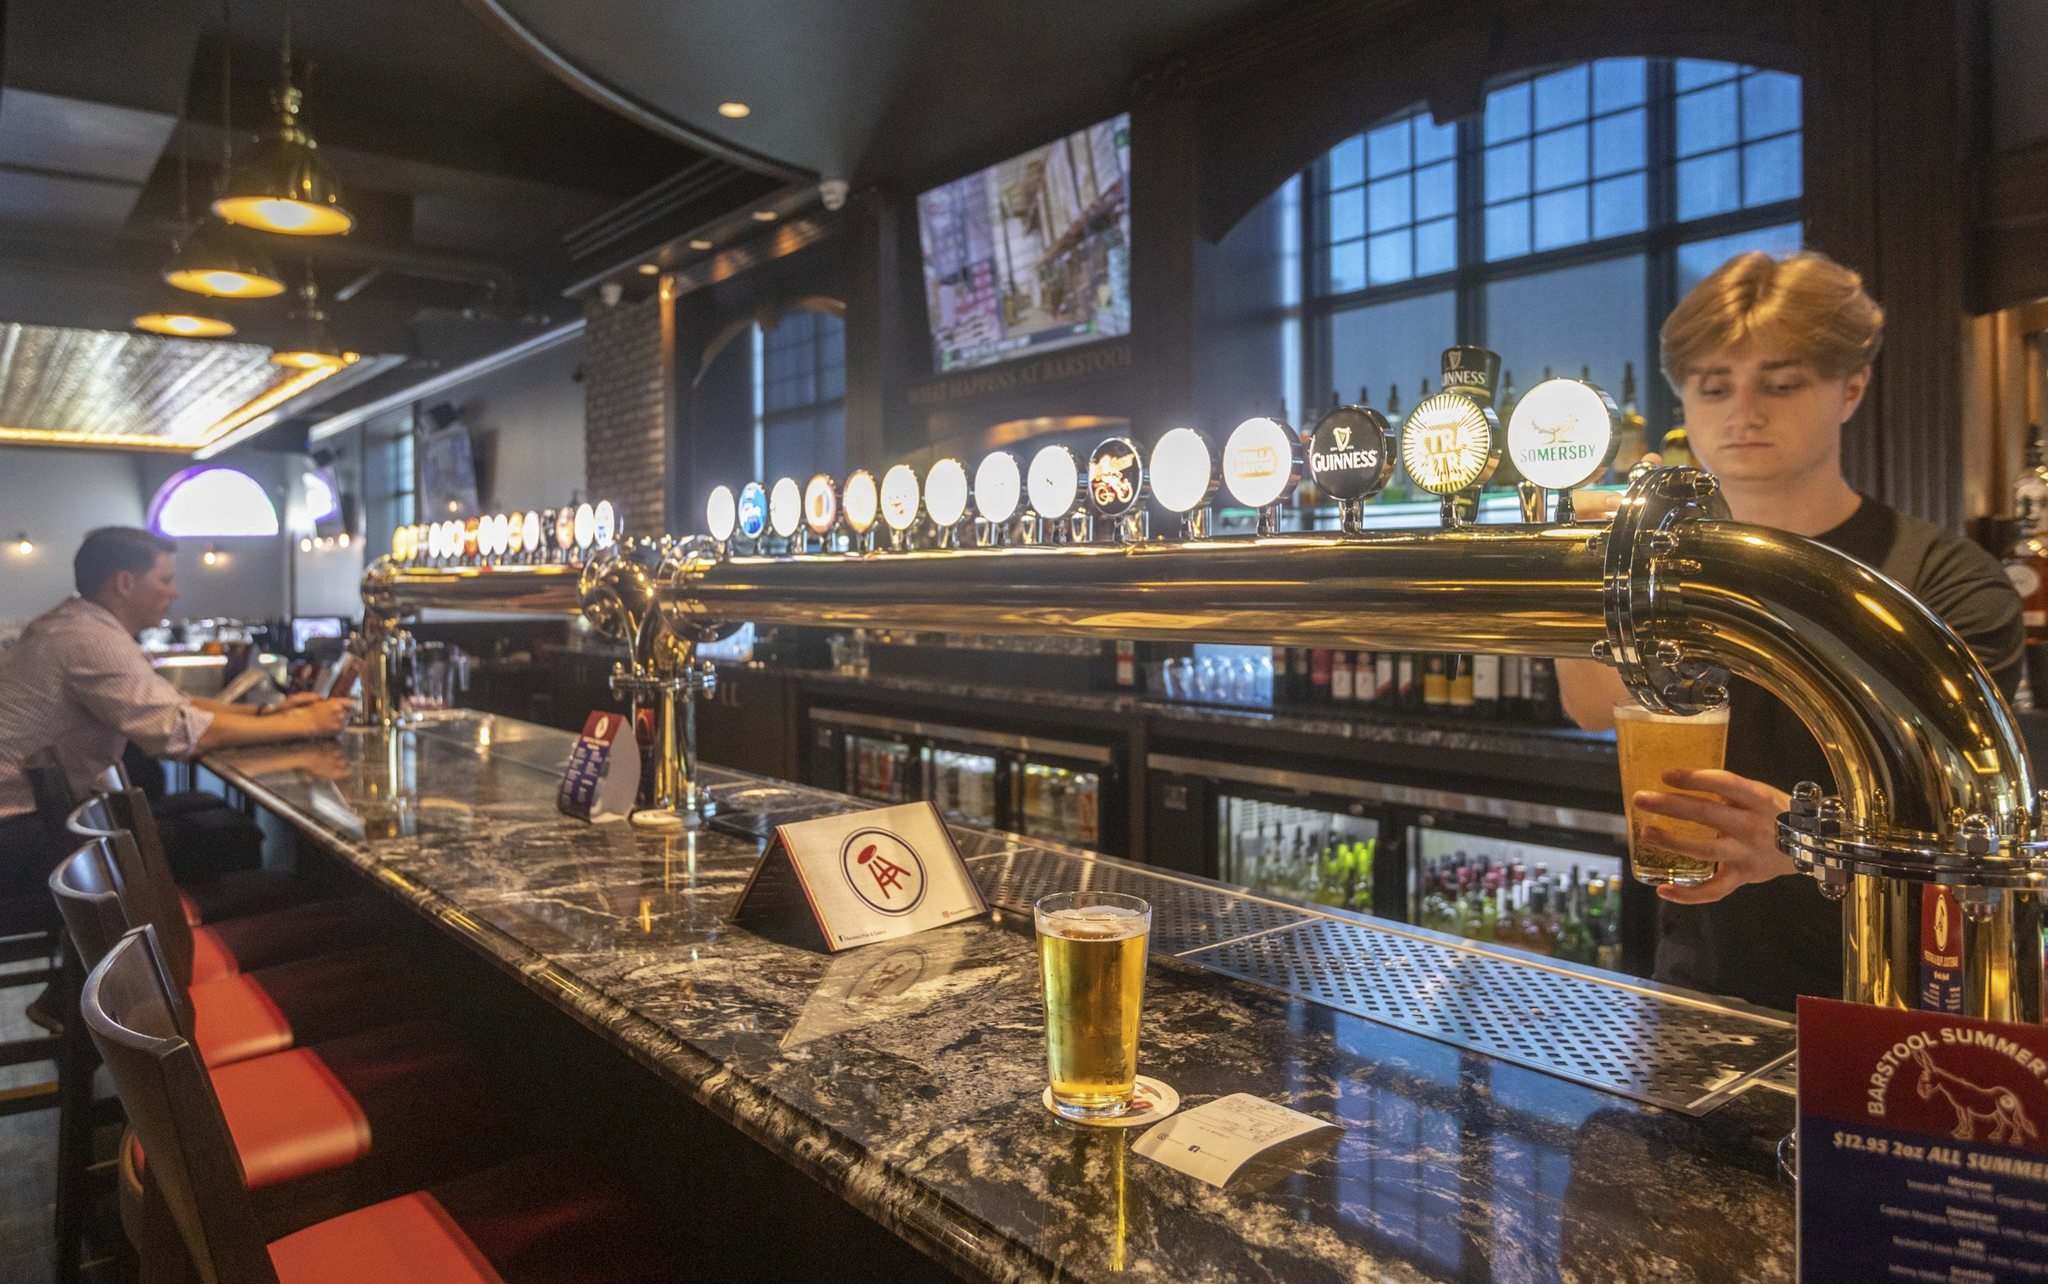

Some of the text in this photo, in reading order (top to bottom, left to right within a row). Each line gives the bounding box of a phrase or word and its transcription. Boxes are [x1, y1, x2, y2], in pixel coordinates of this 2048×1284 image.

[1311, 449, 1378, 473] GUINNESS
[1519, 444, 1597, 463] SOMERSBY
[1868, 1027, 2047, 1116] BARSTOOL SUMMER
[1833, 1131, 1888, 1153] $12.95
[1926, 1146, 1963, 1167] ALL
[1966, 1152, 2048, 1180] SUMME
